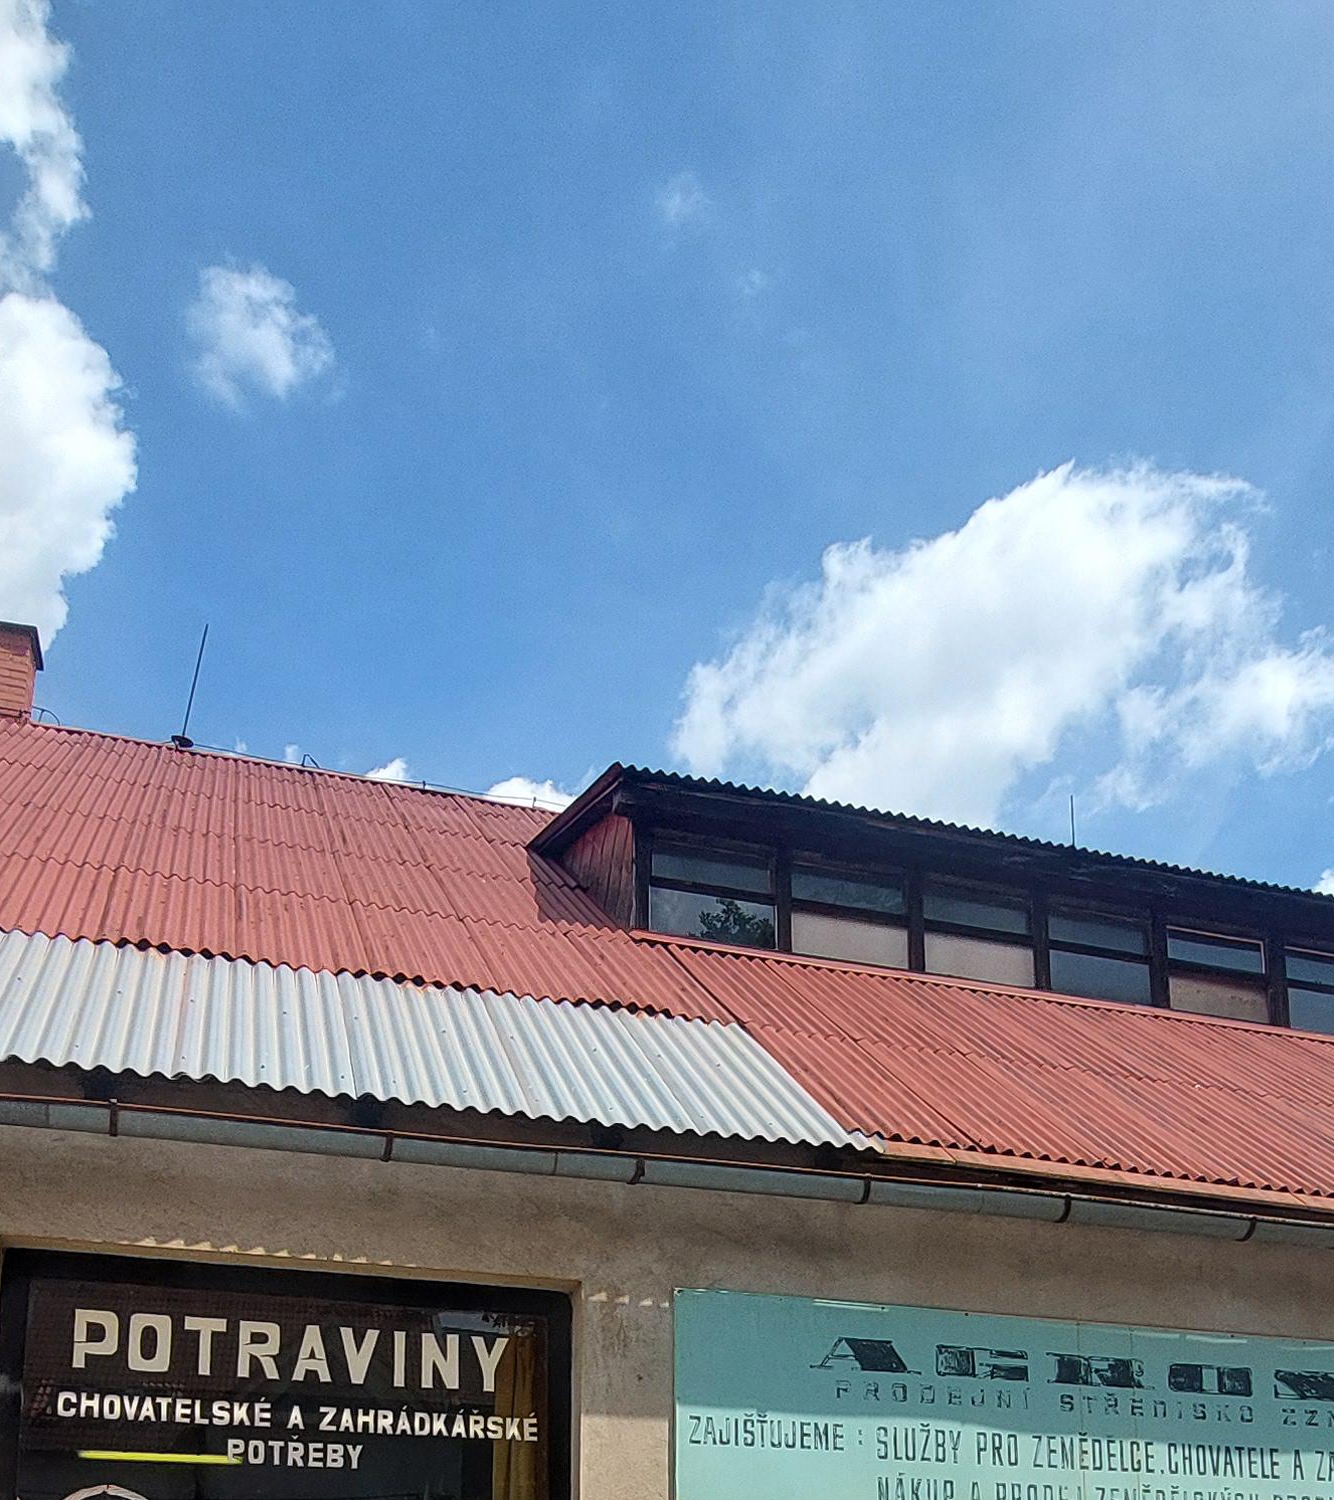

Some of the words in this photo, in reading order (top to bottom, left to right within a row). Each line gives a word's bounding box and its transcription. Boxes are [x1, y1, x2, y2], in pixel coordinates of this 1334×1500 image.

[71, 1308, 509, 1393] POTRAVINY
[57, 1391, 271, 1430] CHOVATELSKÉ
[286, 1406, 305, 1431] A
[319, 1405, 539, 1443] ZAHRÁDKÁŘSKÉ
[689, 1413, 845, 1451] ZAJIŠŤUJEME
[876, 1422, 962, 1464] SLUŽBY
[976, 1431, 1018, 1467] PRO
[1292, 1449, 1305, 1481] A
[227, 1435, 365, 1470] POTŘEBY
